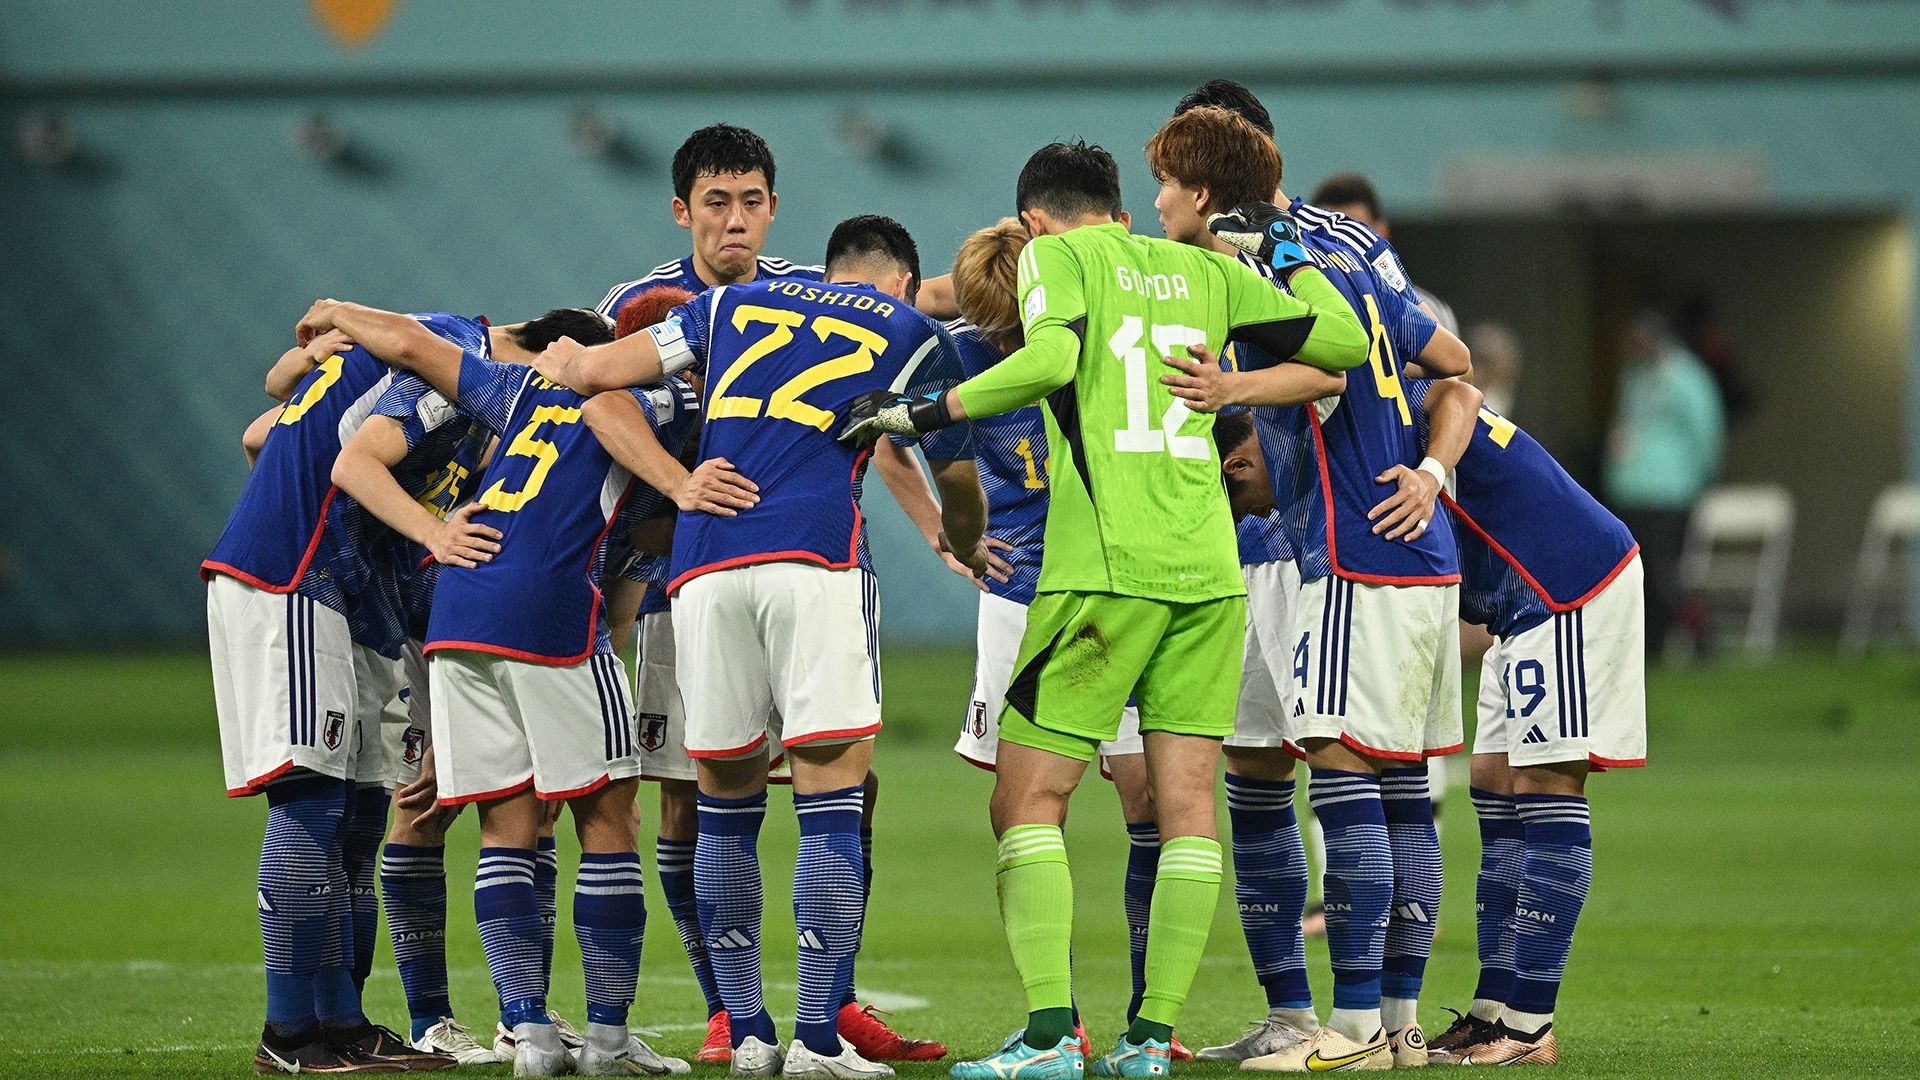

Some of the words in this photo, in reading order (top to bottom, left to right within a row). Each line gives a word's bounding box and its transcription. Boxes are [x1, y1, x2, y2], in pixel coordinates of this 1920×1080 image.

[767, 281, 895, 318] YOSHIDA
[1116, 266, 1190, 301] GONDA
[705, 304, 889, 433] 22
[1107, 315, 1212, 461] 12
[1363, 294, 1413, 426] 4
[478, 405, 582, 512] 5
[1502, 659, 1547, 719] 19
[397, 929, 446, 943] JAPA
